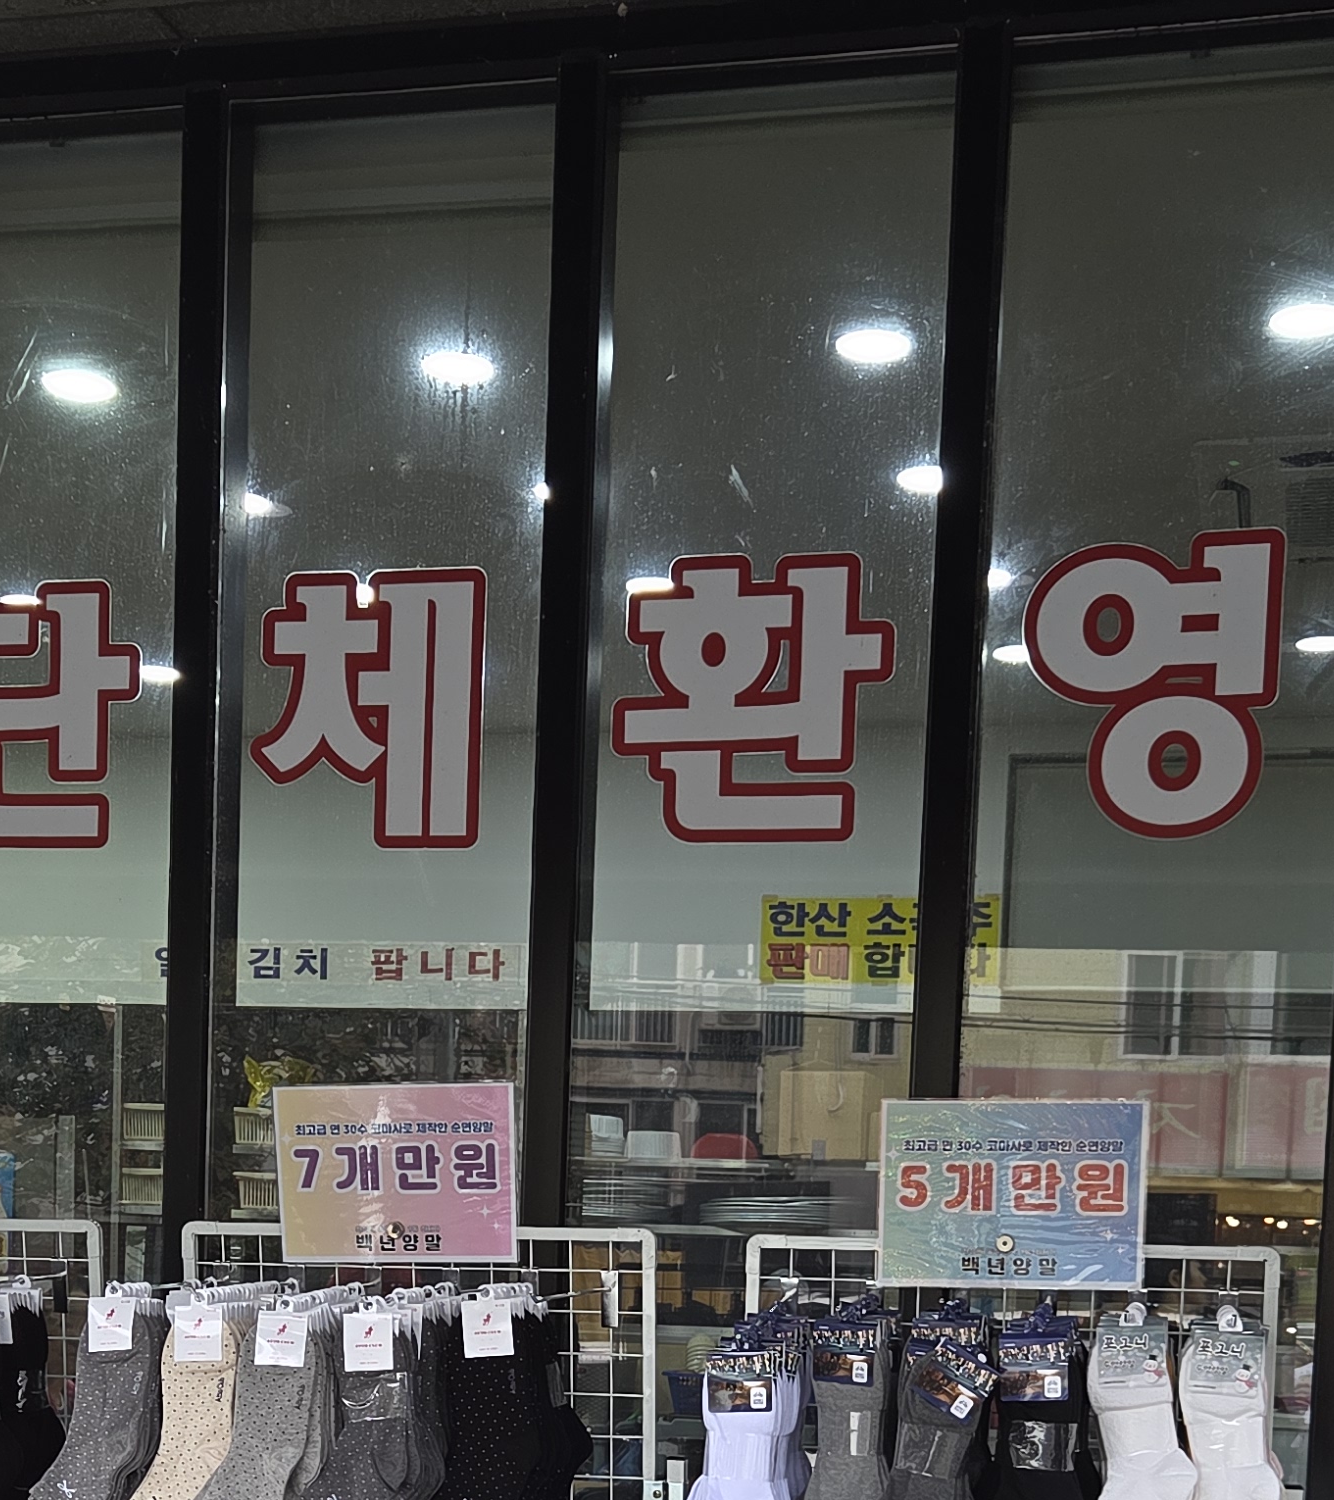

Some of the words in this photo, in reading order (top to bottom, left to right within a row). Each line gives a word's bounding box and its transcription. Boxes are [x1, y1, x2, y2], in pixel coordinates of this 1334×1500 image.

[768, 901, 852, 938] 한산
[867, 901, 993, 938] 소주
[247, 946, 328, 980] 김치
[370, 947, 506, 981] 팝니다
[766, 942, 850, 980] 판매
